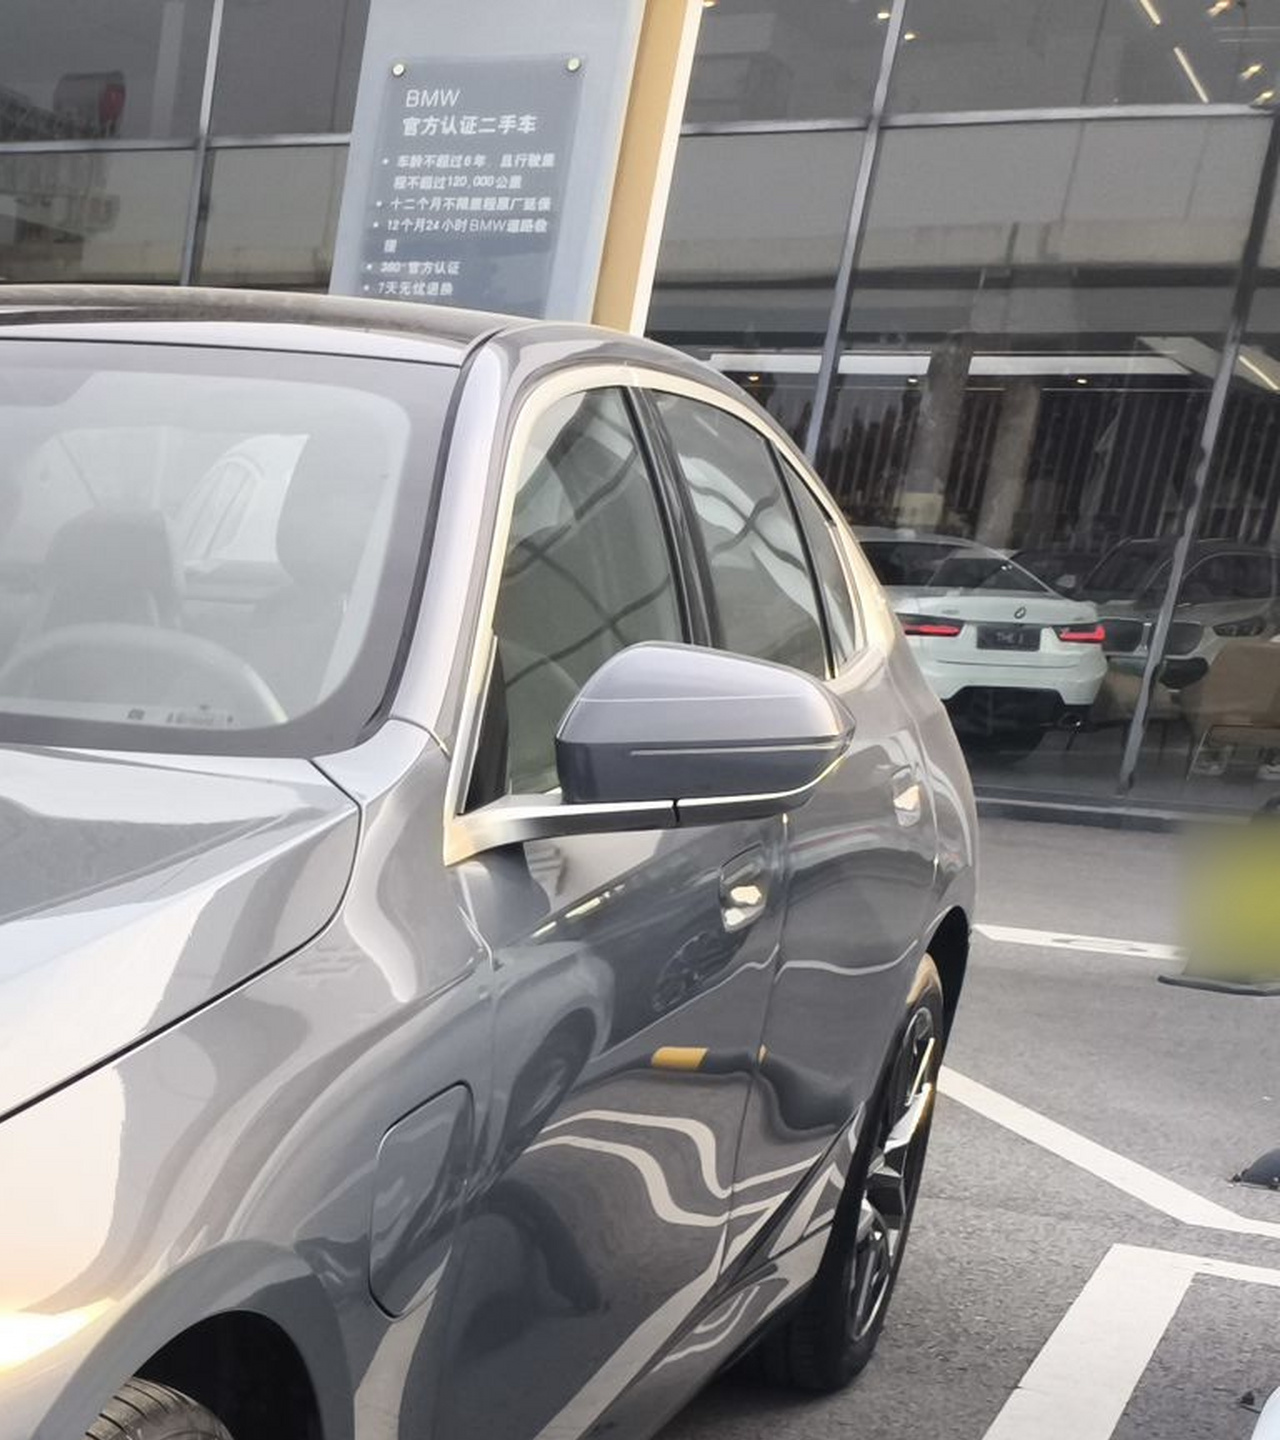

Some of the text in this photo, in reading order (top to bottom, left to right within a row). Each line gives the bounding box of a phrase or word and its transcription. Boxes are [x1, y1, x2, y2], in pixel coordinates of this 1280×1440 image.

[405, 88, 461, 108] BMW
[402, 114, 538, 136] 官方认证二手车
